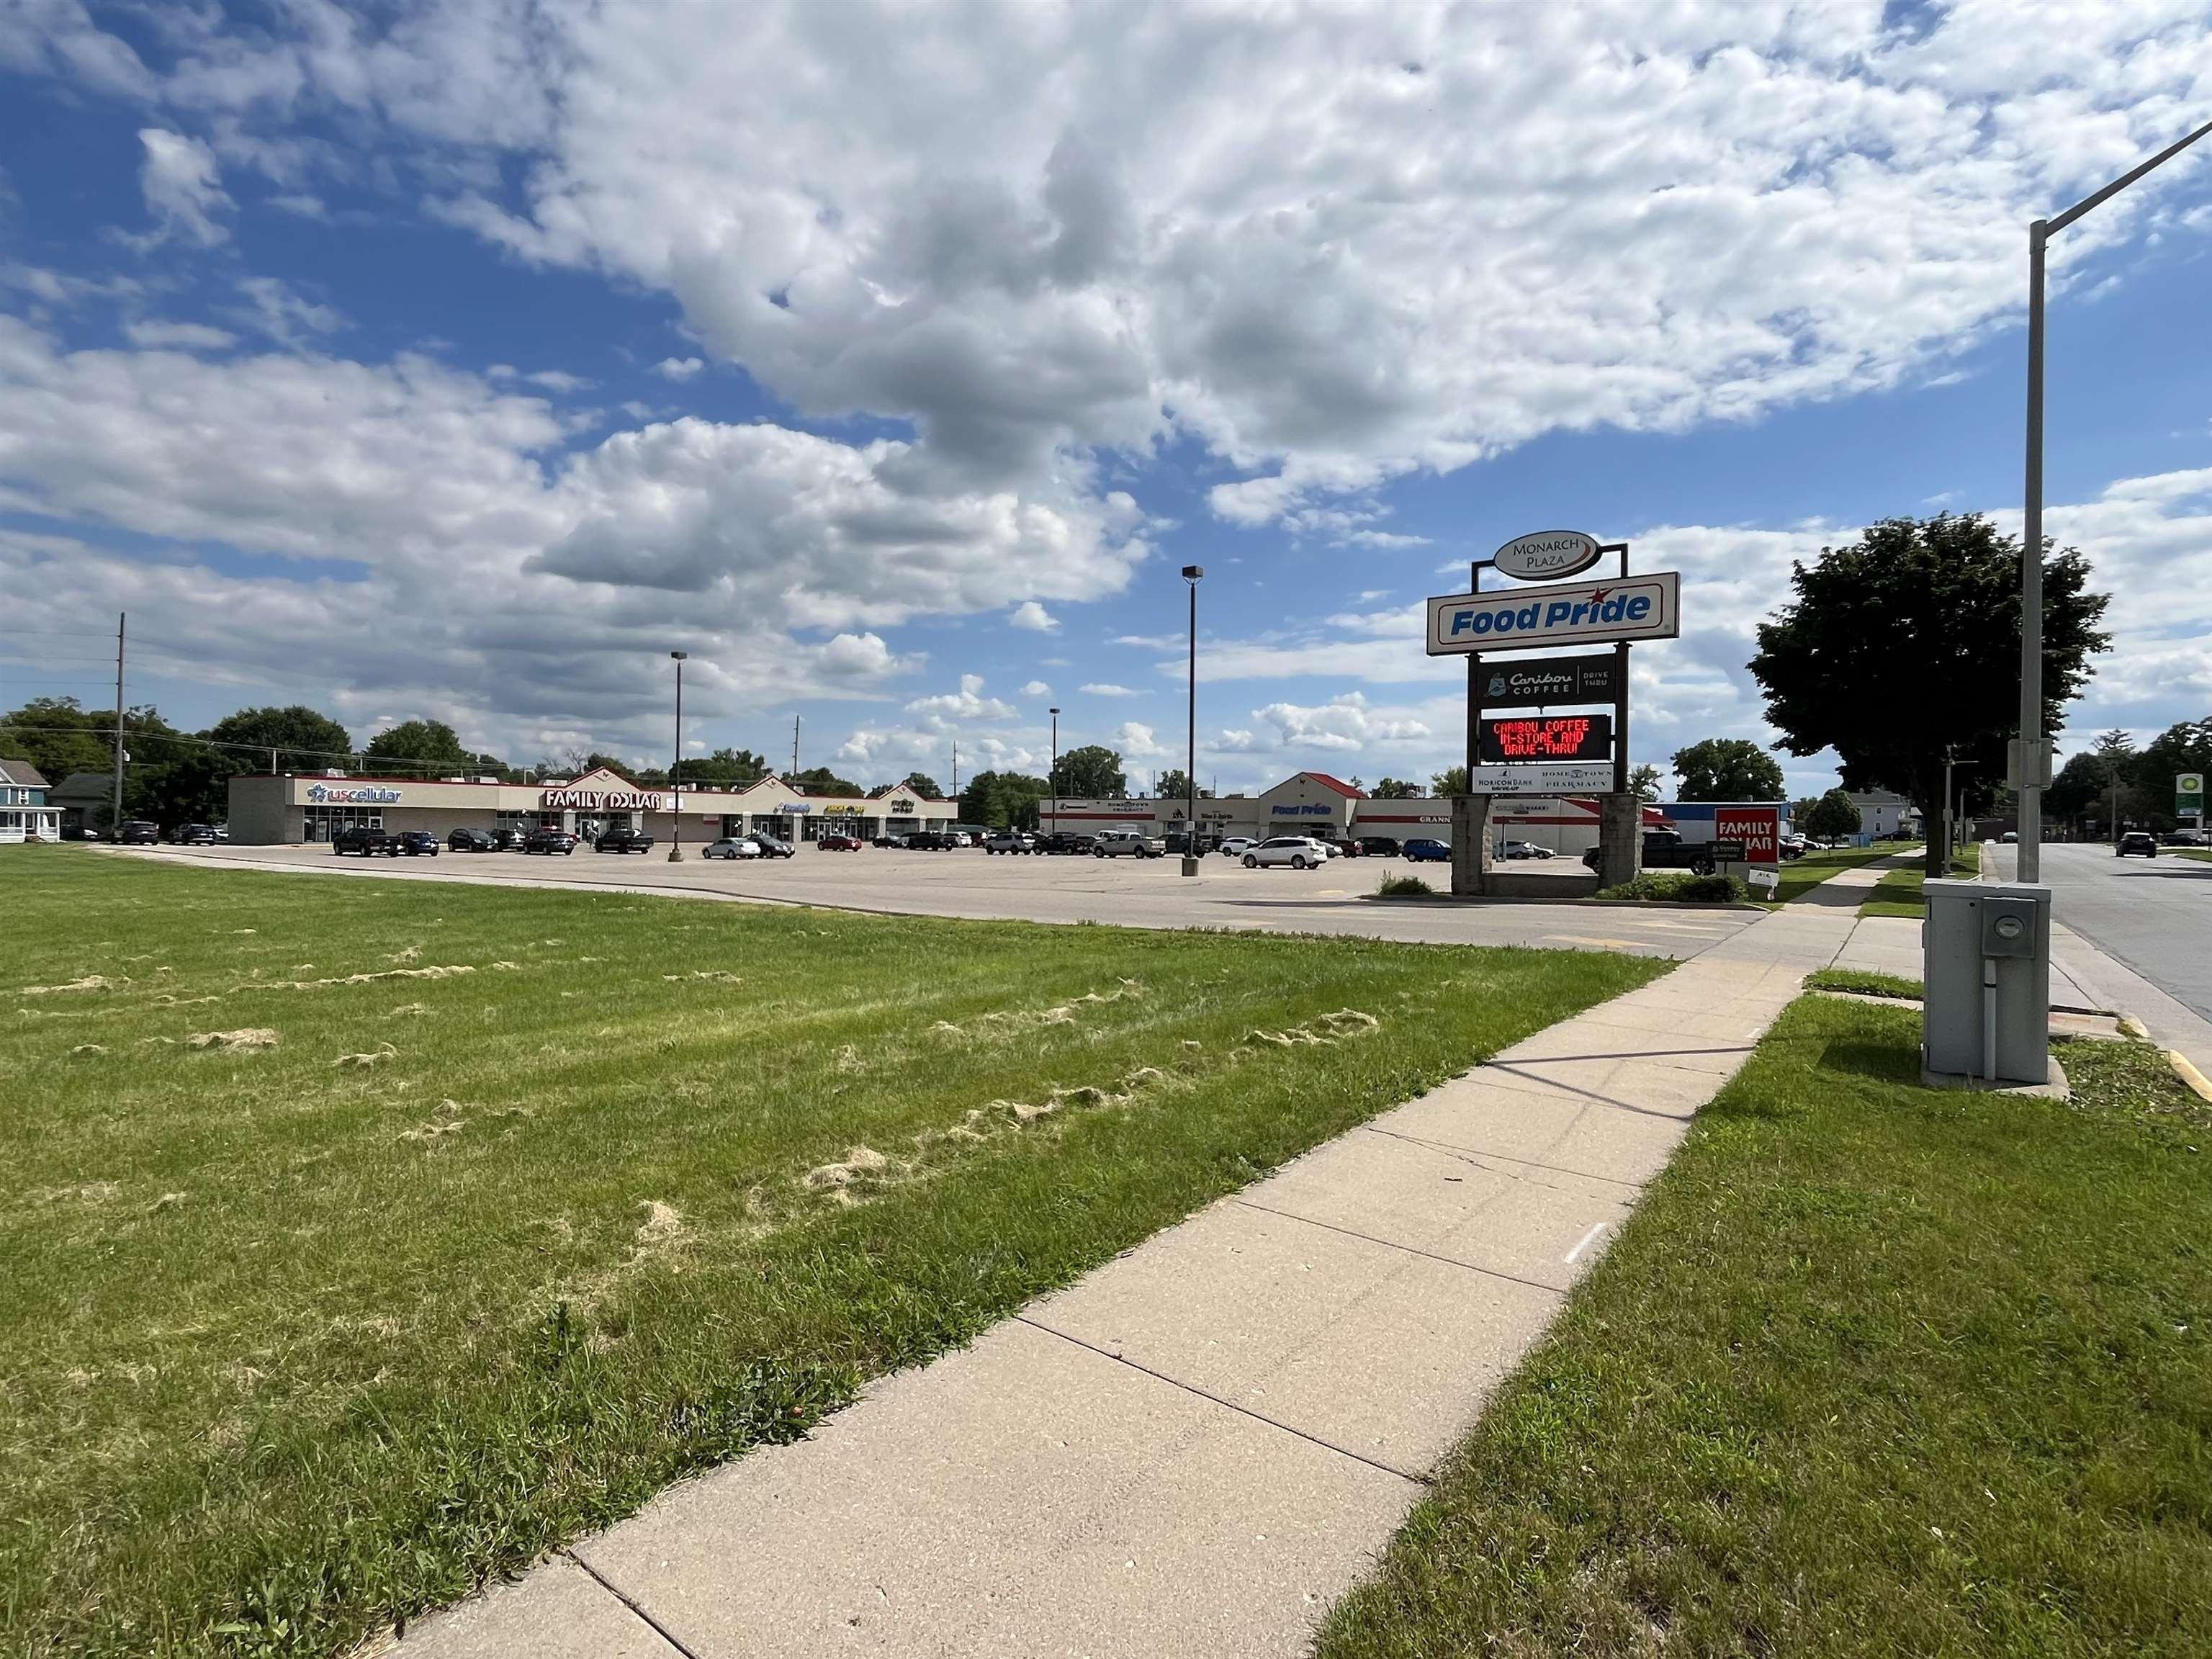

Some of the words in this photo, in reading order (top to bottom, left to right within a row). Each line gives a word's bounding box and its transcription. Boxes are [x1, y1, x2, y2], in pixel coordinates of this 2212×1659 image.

[1514, 539, 1579, 556] MONARCH
[1527, 555, 1565, 568] PLAZA
[1450, 603, 1542, 636] Food
[1545, 594, 1651, 628] Pride
[1510, 673, 1573, 685] Caribou
[1514, 685, 1570, 695] COFFEE
[1493, 721, 1539, 734] CARIBOU
[1545, 719, 1589, 732] COFFEE
[1501, 732, 1555, 745] IN-STORE
[1561, 731, 1584, 743] AND
[545, 791, 603, 808] FAMILY
[610, 792, 661, 809] DOLLAR
[1719, 822, 1772, 835] FAMILY
